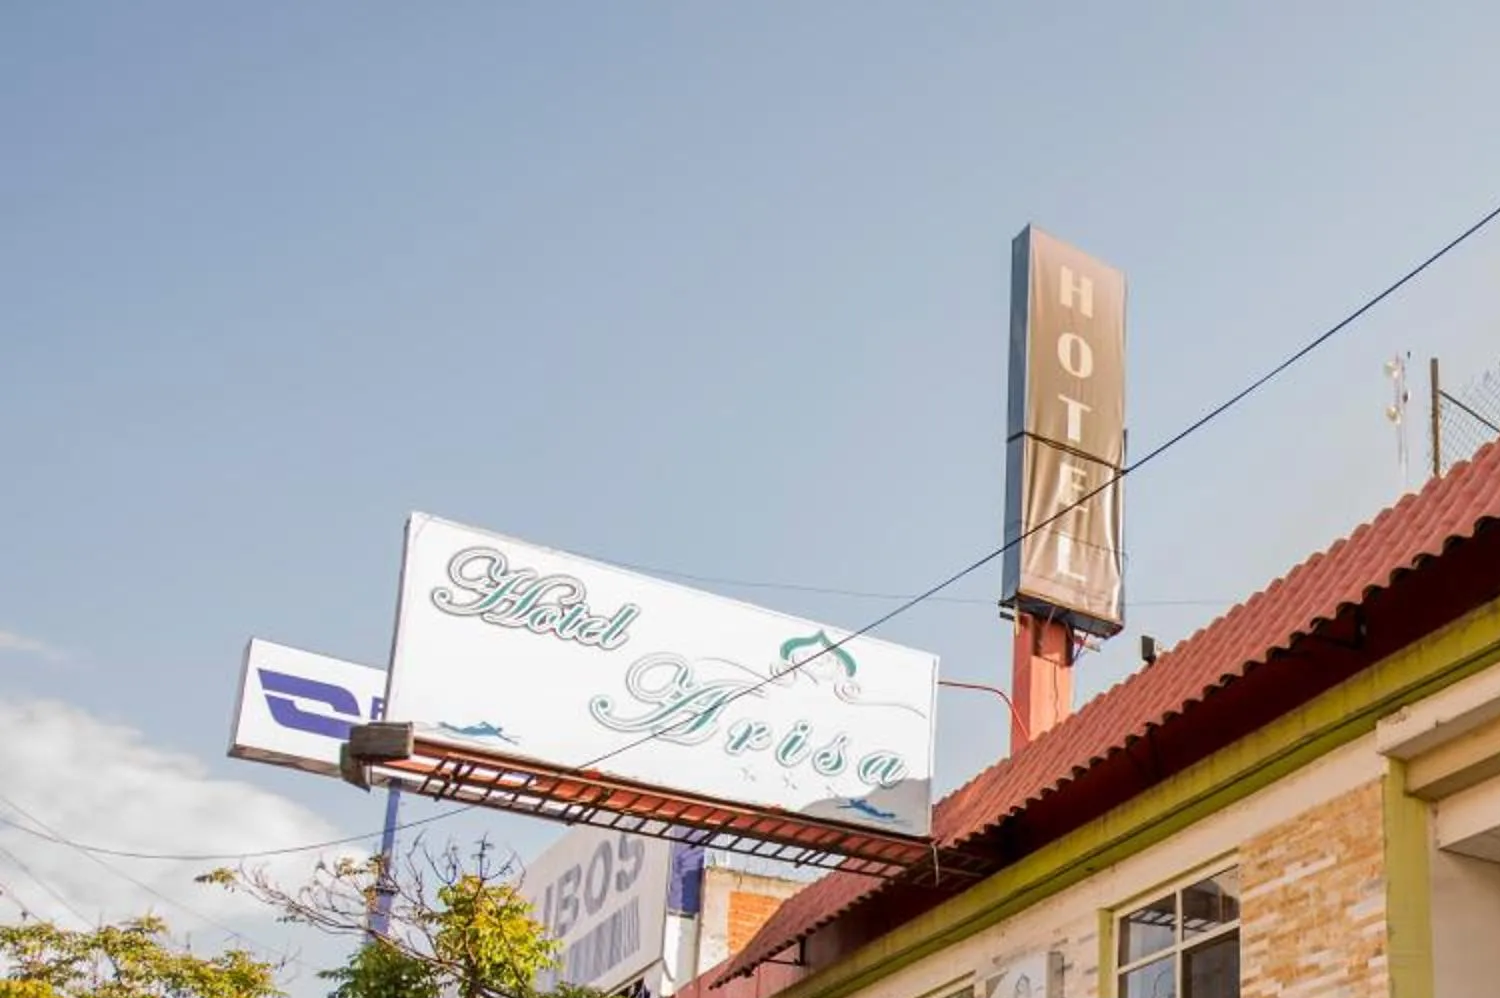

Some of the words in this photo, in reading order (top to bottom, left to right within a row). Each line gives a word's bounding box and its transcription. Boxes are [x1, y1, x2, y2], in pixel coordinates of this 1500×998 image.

[1056, 265, 1094, 584] HOTEL
[431, 546, 641, 650] Hotel
[589, 651, 910, 789] Arisa
